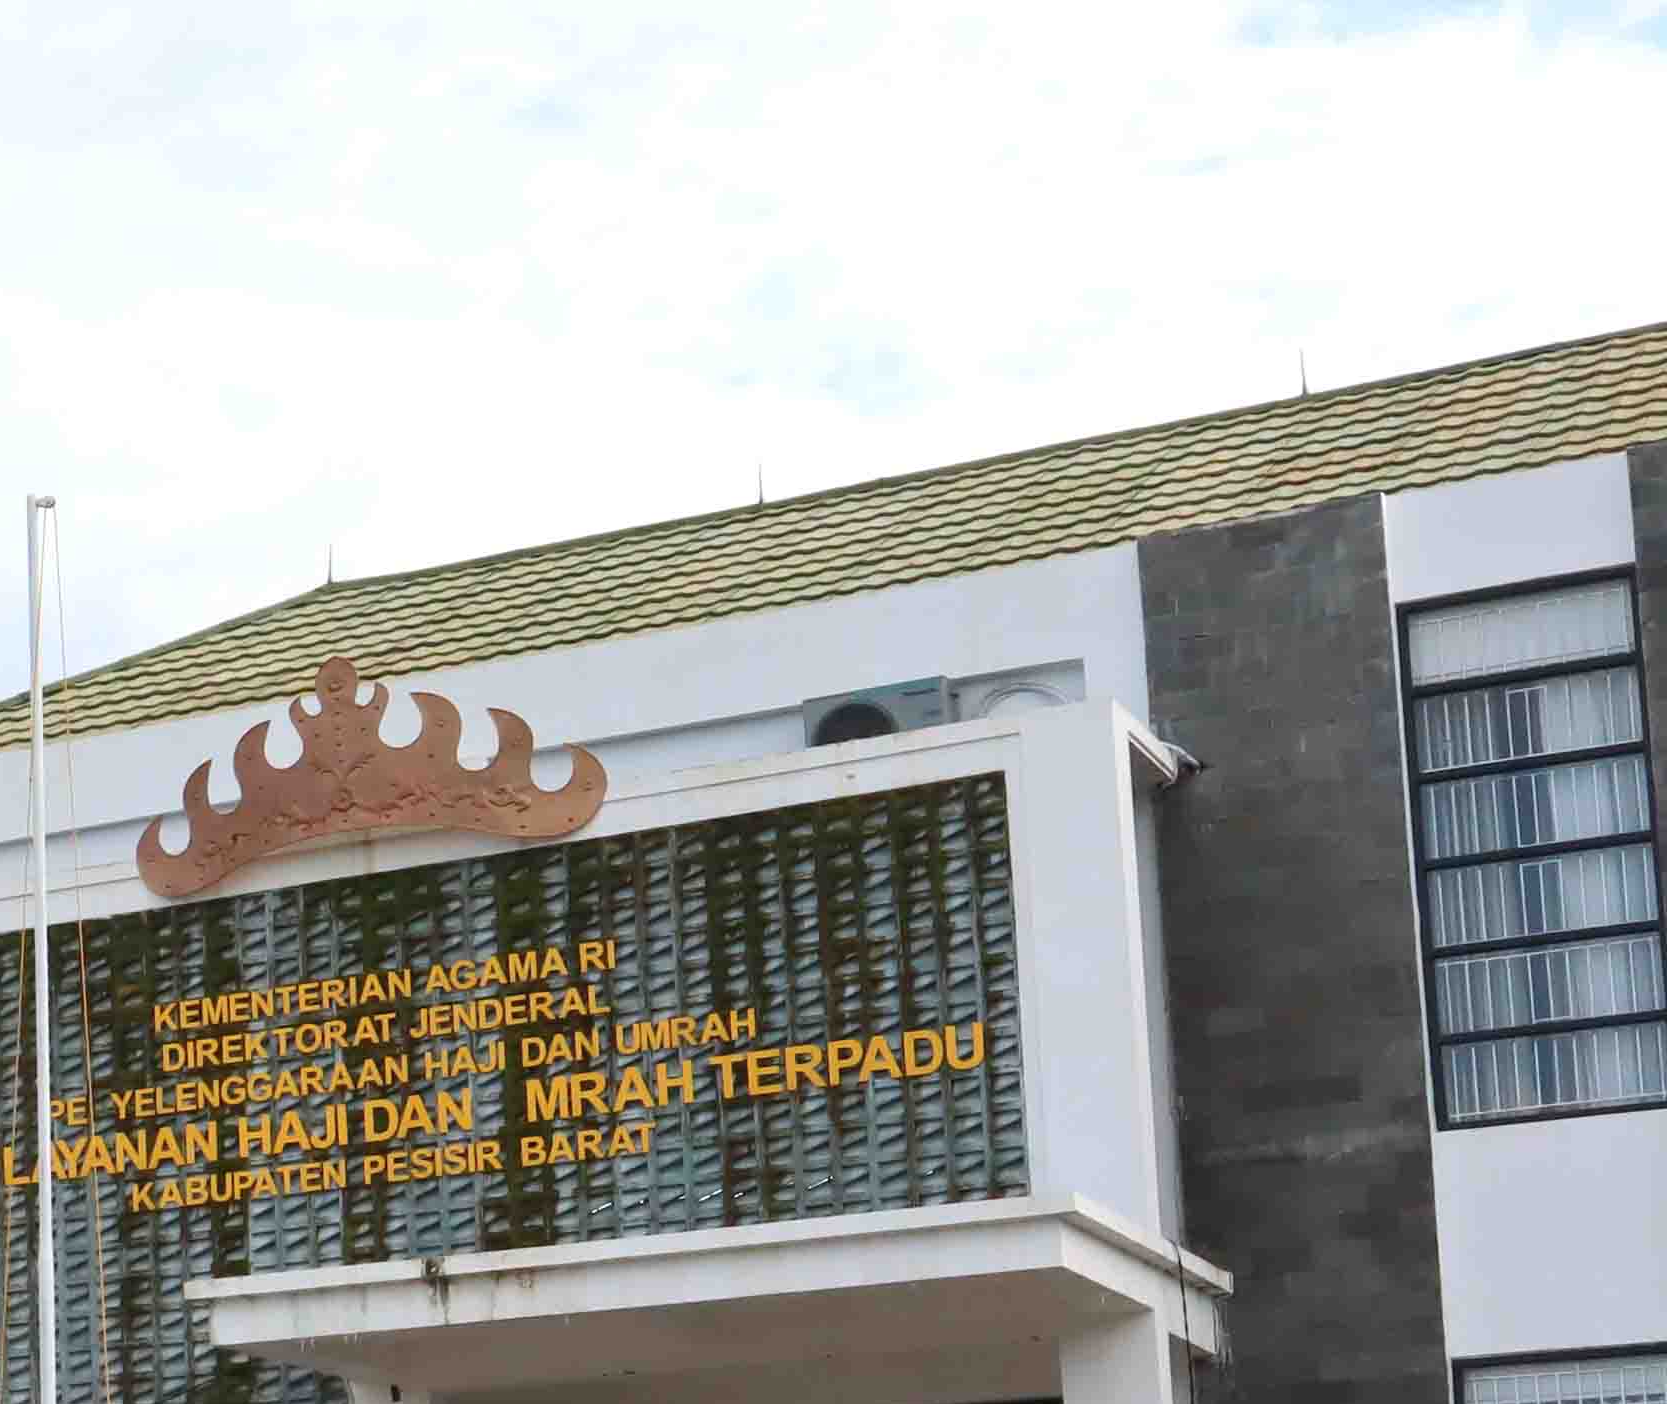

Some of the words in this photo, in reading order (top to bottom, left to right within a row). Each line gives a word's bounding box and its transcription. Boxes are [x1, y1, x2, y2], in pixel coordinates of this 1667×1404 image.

[153, 967, 412, 1032] KEMENTERIAN
[425, 946, 567, 993] AGAMA
[579, 939, 616, 971] RI
[162, 1011, 397, 1073] DIREKTORAT
[410, 984, 611, 1039] JENDERAL
[424, 1040, 507, 1080] HAJI
[521, 1030, 600, 1068] DAN
[615, 1007, 757, 1054] UMRAH
[2, 1120, 218, 1187] LAYANAN
[238, 1104, 349, 1158] HAJI
[363, 1086, 473, 1143] DAN
[525, 1058, 695, 1122] MRAH
[708, 1022, 985, 1099] TERPADU
[132, 1160, 347, 1212] KABUPATEN
[362, 1136, 503, 1185] PESISIR
[520, 1122, 654, 1167] BARAT
